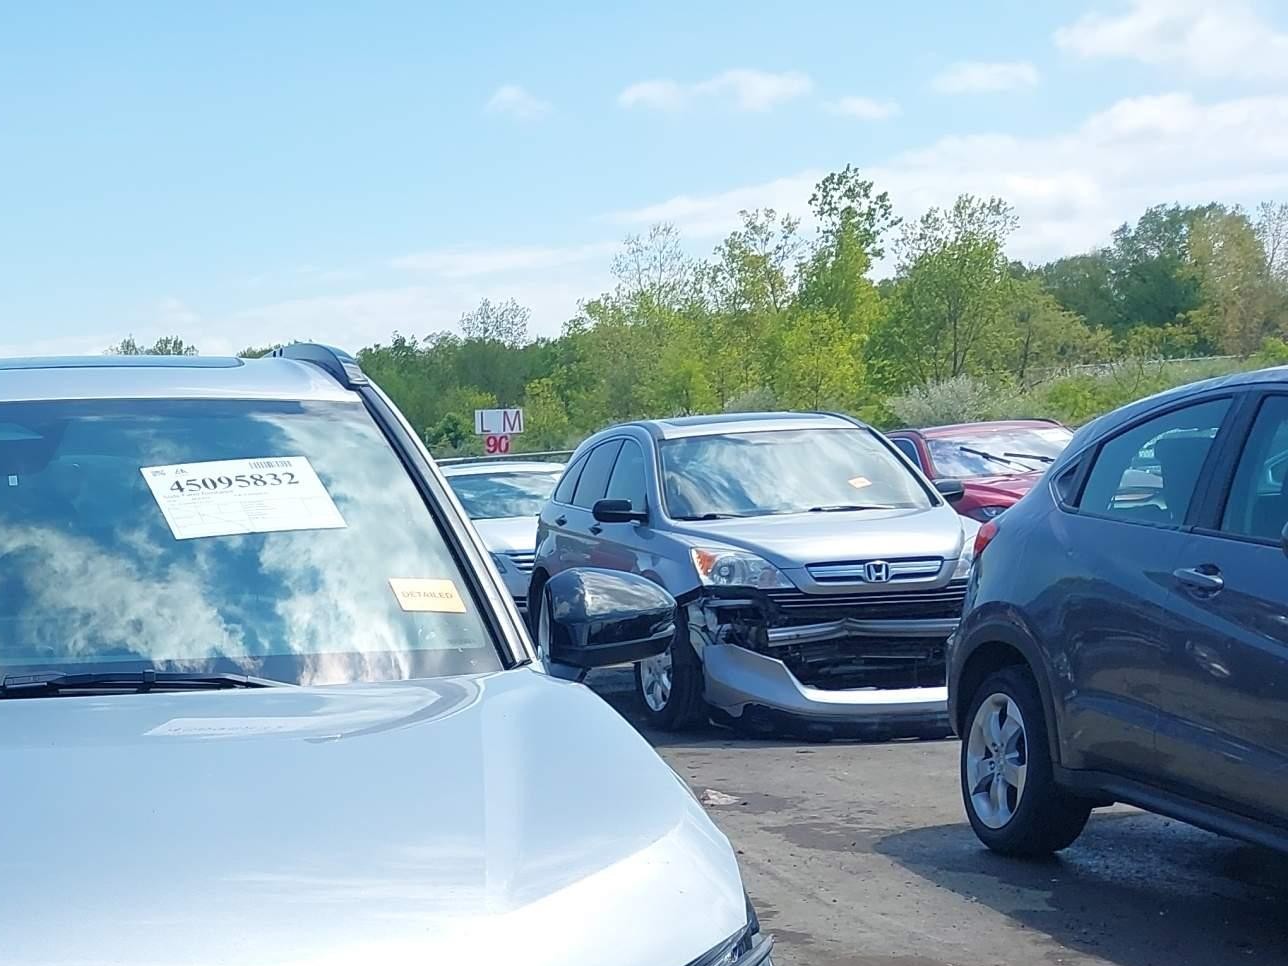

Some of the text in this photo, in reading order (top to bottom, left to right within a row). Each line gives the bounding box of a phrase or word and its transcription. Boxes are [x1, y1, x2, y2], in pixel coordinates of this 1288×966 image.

[480, 410, 522, 433] L M
[486, 435, 510, 454] 90
[169, 471, 300, 493] 45095832
[401, 590, 454, 600] DETAILED
